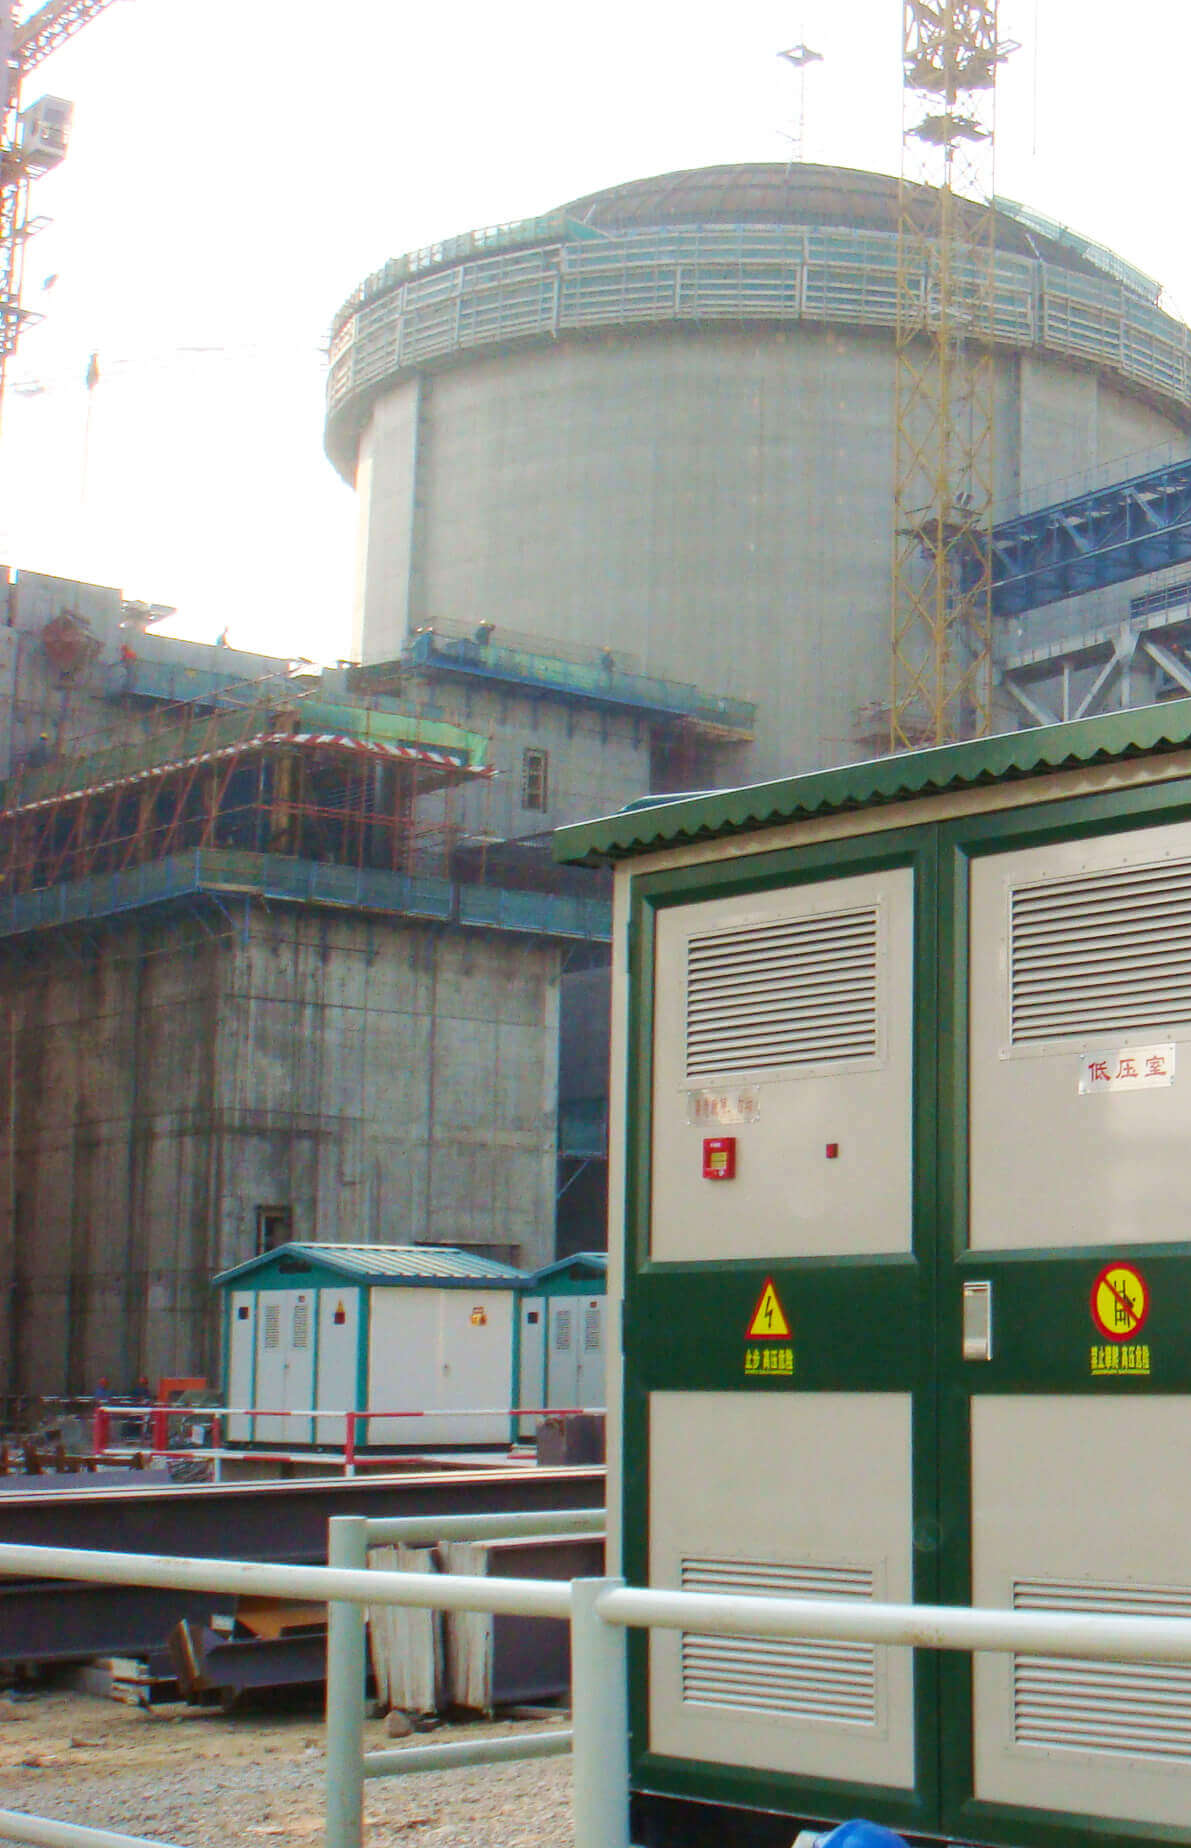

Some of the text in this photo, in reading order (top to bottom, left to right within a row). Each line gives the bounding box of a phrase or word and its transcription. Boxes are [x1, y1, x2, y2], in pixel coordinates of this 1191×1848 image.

[1088, 1056, 1166, 1082] 低压室
[745, 1348, 760, 1368] 止步
